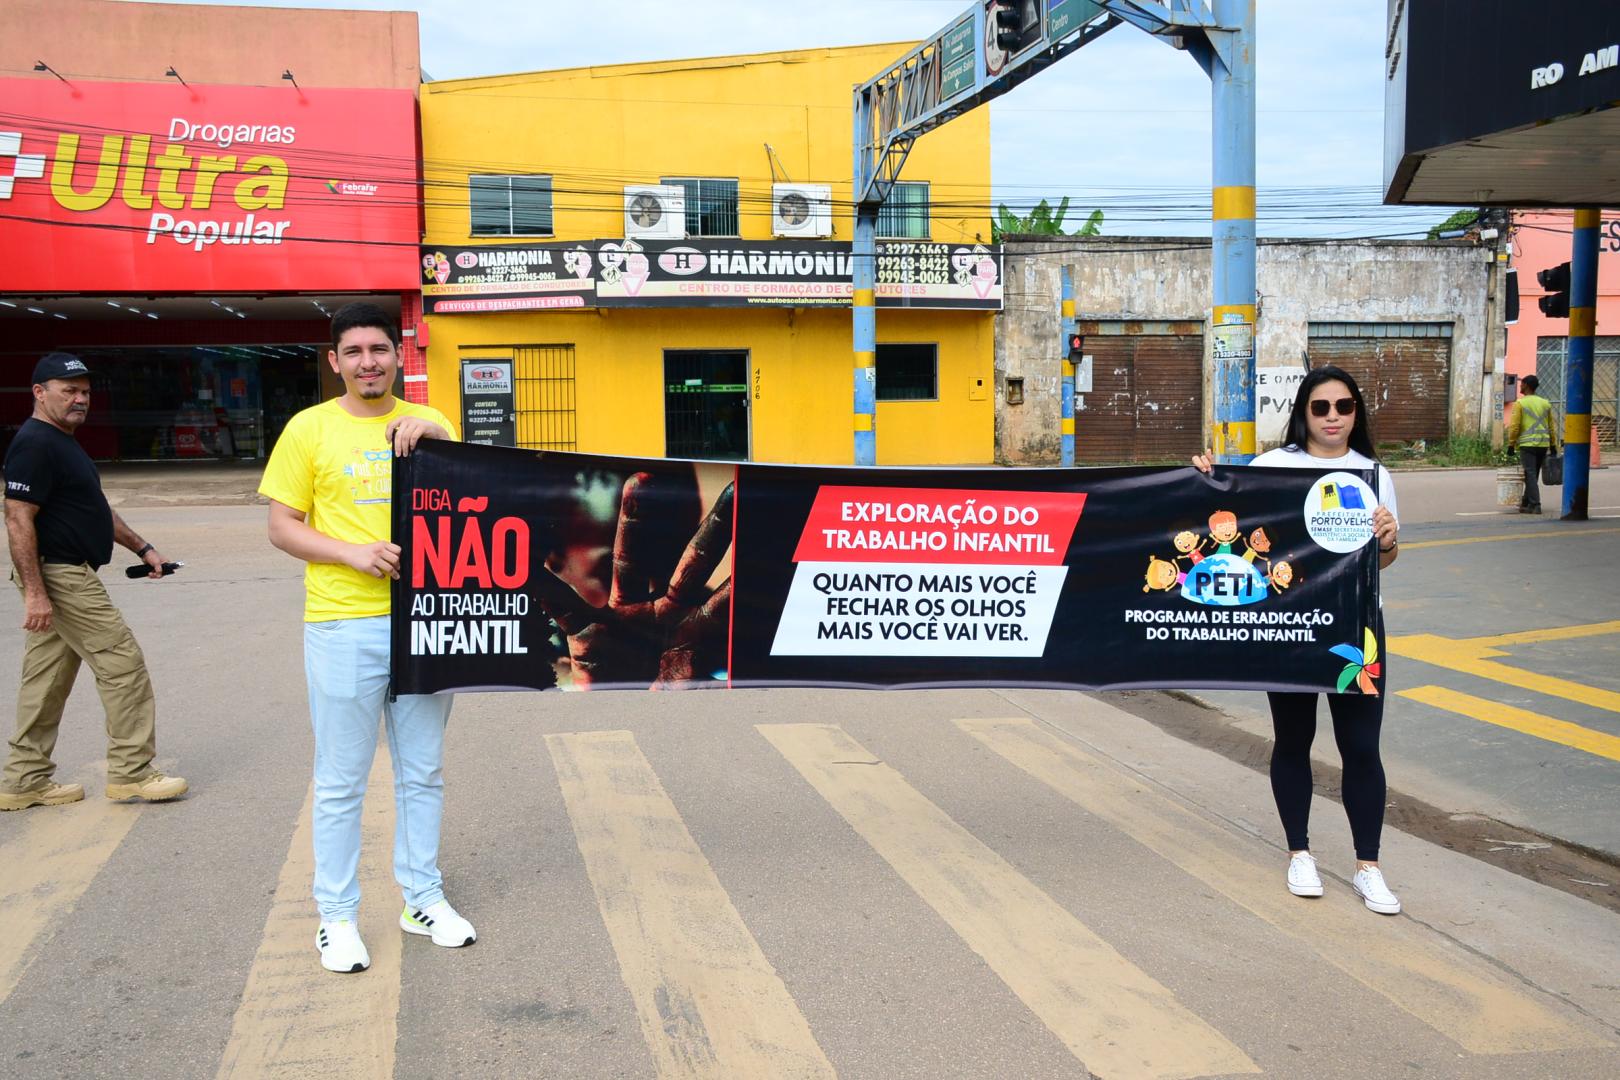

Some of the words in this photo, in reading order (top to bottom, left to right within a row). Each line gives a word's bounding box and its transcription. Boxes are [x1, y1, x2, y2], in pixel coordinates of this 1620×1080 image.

[1052, 14, 1069, 32] Centro
[1531, 62, 1564, 90] RO
[1578, 45, 1619, 76] AM
[168, 118, 296, 148] Drogarias
[50, 133, 290, 211] Ultra
[343, 183, 378, 192] Febrafar
[146, 213, 290, 252] Popular
[478, 250, 552, 267] HARMONIA
[885, 244, 949, 257] 3227-3663
[492, 265, 527, 274] 3227-3663
[878, 257, 949, 271] 99263-8422
[464, 274, 503, 283] 99263-8422
[516, 272, 556, 281] 99945-0062
[878, 271, 949, 284] 99945-0062
[679, 283, 729, 293] CENTRO
[734, 284, 750, 293] DE
[826, 284, 841, 293] DE
[440, 302, 474, 310] SERVIÇOS
[477, 301, 485, 309] DE
[488, 299, 545, 309] DESPACHANTES
[560, 298, 583, 306] GERAL
[467, 381, 508, 389] HARMONIA
[412, 488, 451, 511] DIGA
[841, 499, 997, 530] EXPLORAÇÃO
[1003, 506, 1039, 526] DO
[1311, 516, 1342, 526] PORTO
[1344, 517, 1374, 526] VELHO
[411, 496, 530, 590] NÃO
[822, 529, 947, 551] TRABALHO
[953, 531, 1055, 553] INFANTIL
[813, 572, 913, 595] QUANTO
[918, 574, 973, 593] MAIS
[978, 570, 1036, 594] VOCÊ
[1195, 572, 1253, 596] PETI
[410, 593, 435, 616] AO
[438, 592, 529, 616] TRABALHO
[826, 597, 909, 616] FECHAR
[914, 599, 945, 618] OS
[950, 599, 1026, 618] OLHOS
[817, 621, 873, 640] MAIS
[878, 616, 938, 641] VOCÊ
[943, 622, 977, 641] VAI
[983, 622, 1028, 642] VER.
[1125, 609, 1208, 624] PROGRAMA
[1211, 611, 1229, 624] DE
[1232, 609, 1334, 629] ERRADICAÇÃO
[410, 620, 528, 655] INFANTIL
[1146, 627, 1169, 640] DO
[1172, 628, 1249, 641] TRABALHO
[1253, 628, 1316, 642] INFANTIL
